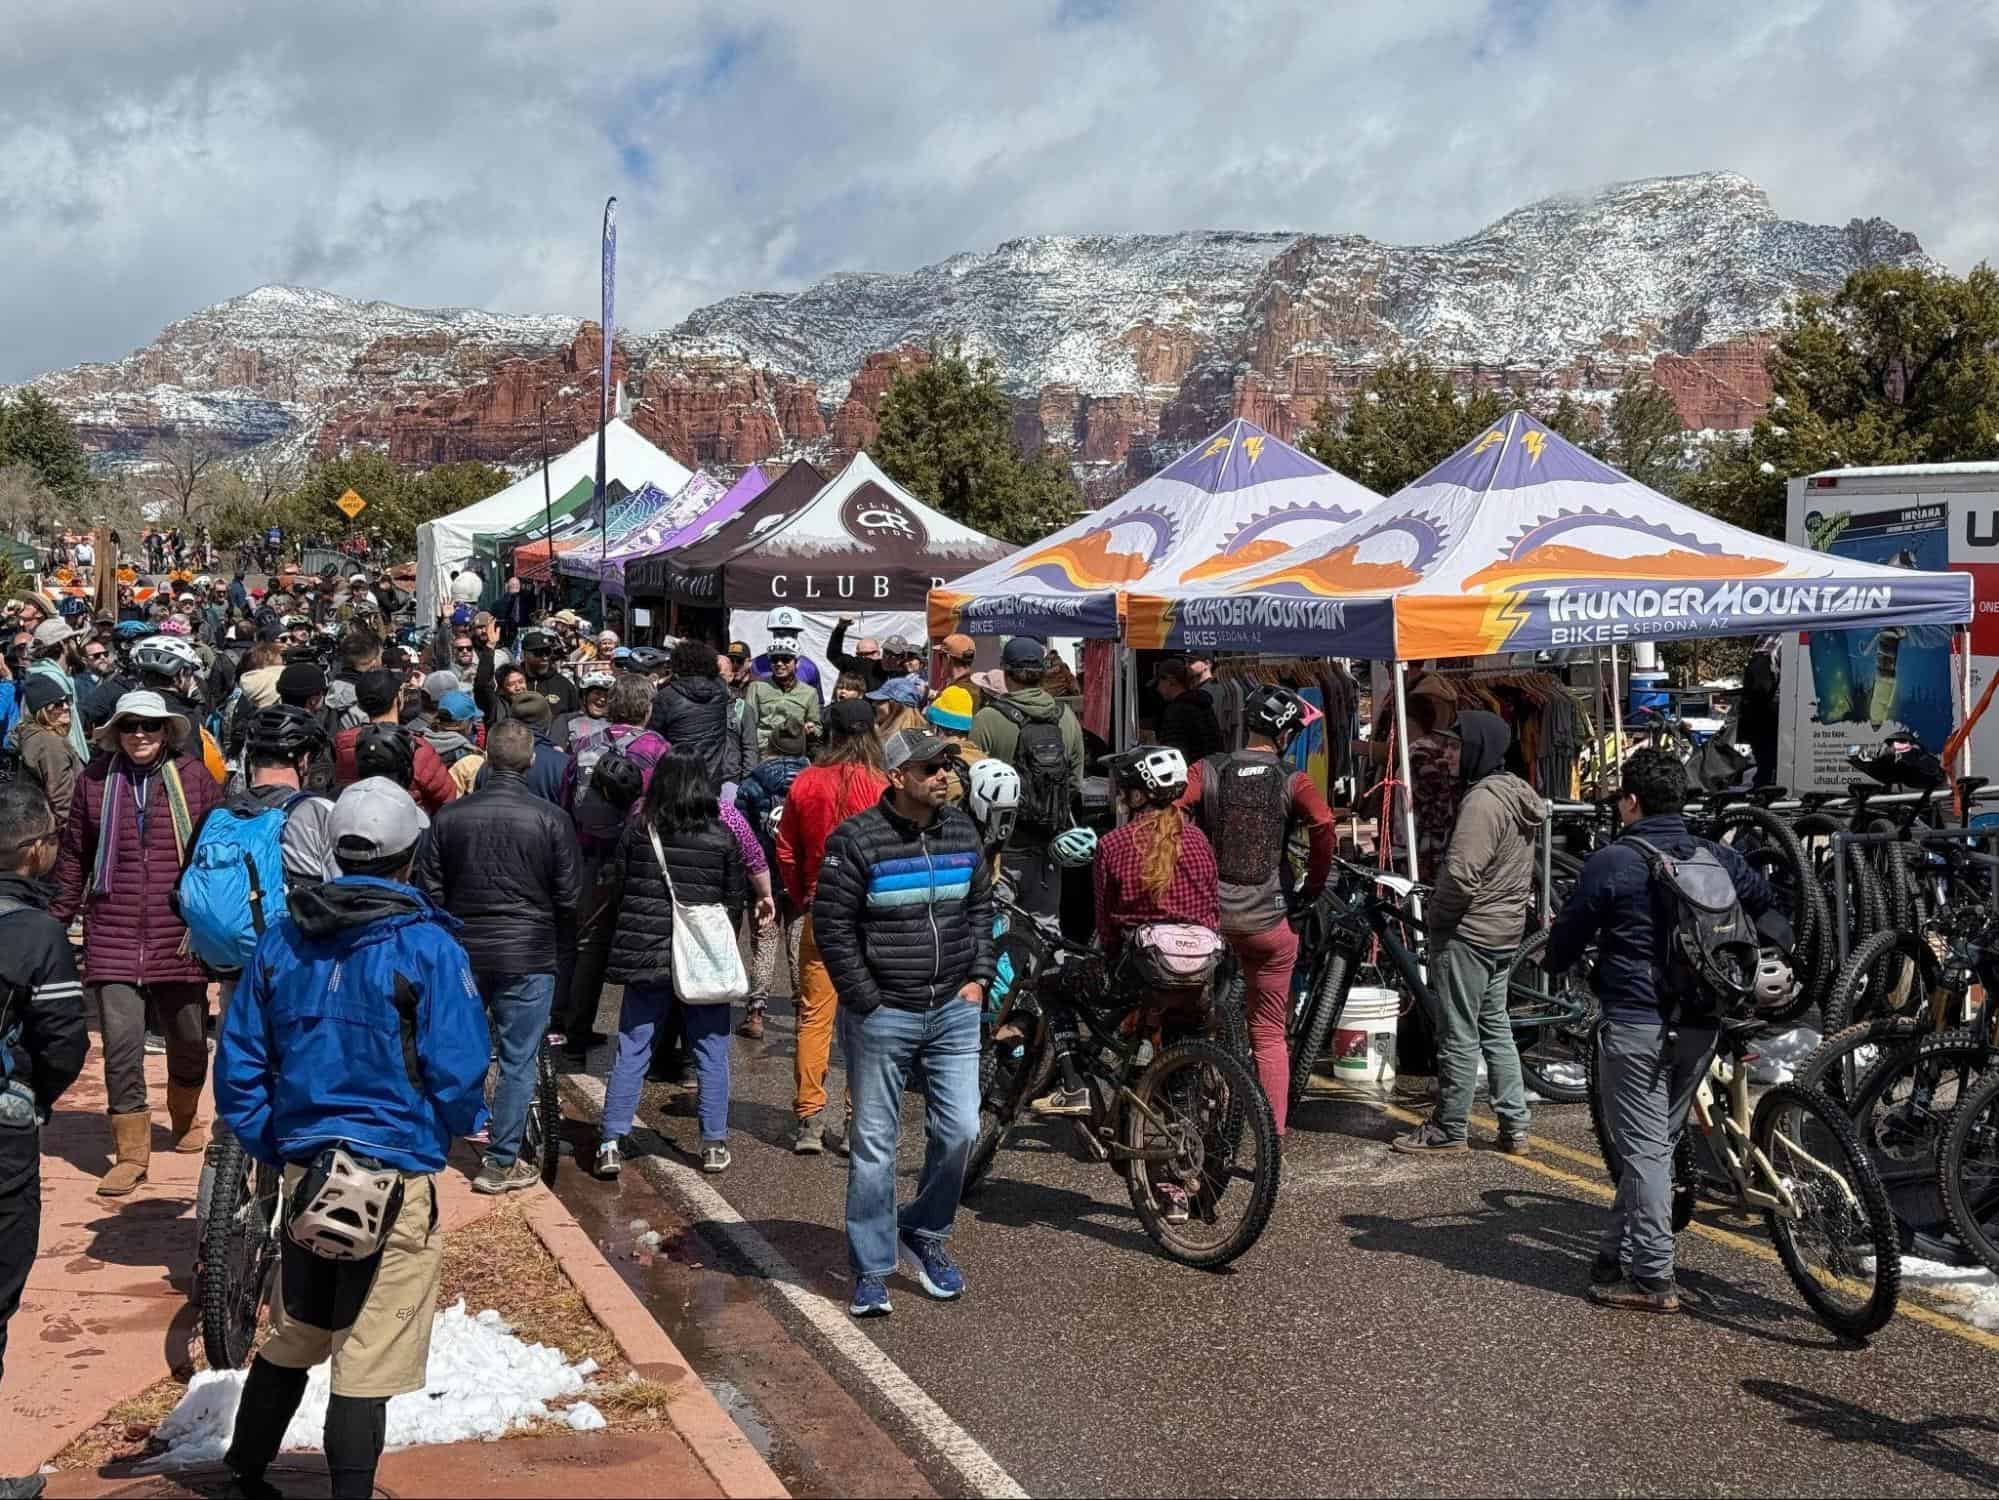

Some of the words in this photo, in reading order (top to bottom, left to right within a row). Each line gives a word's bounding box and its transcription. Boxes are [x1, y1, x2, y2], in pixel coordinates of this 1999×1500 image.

[771, 576, 889, 598] CLUB
[970, 620, 993, 633] BIKES
[1551, 623, 1629, 645] BIKES
[1710, 617, 1729, 630] AZ
[1184, 631, 1217, 646] BIKES
[1813, 775, 1862, 785] uhaul.com
